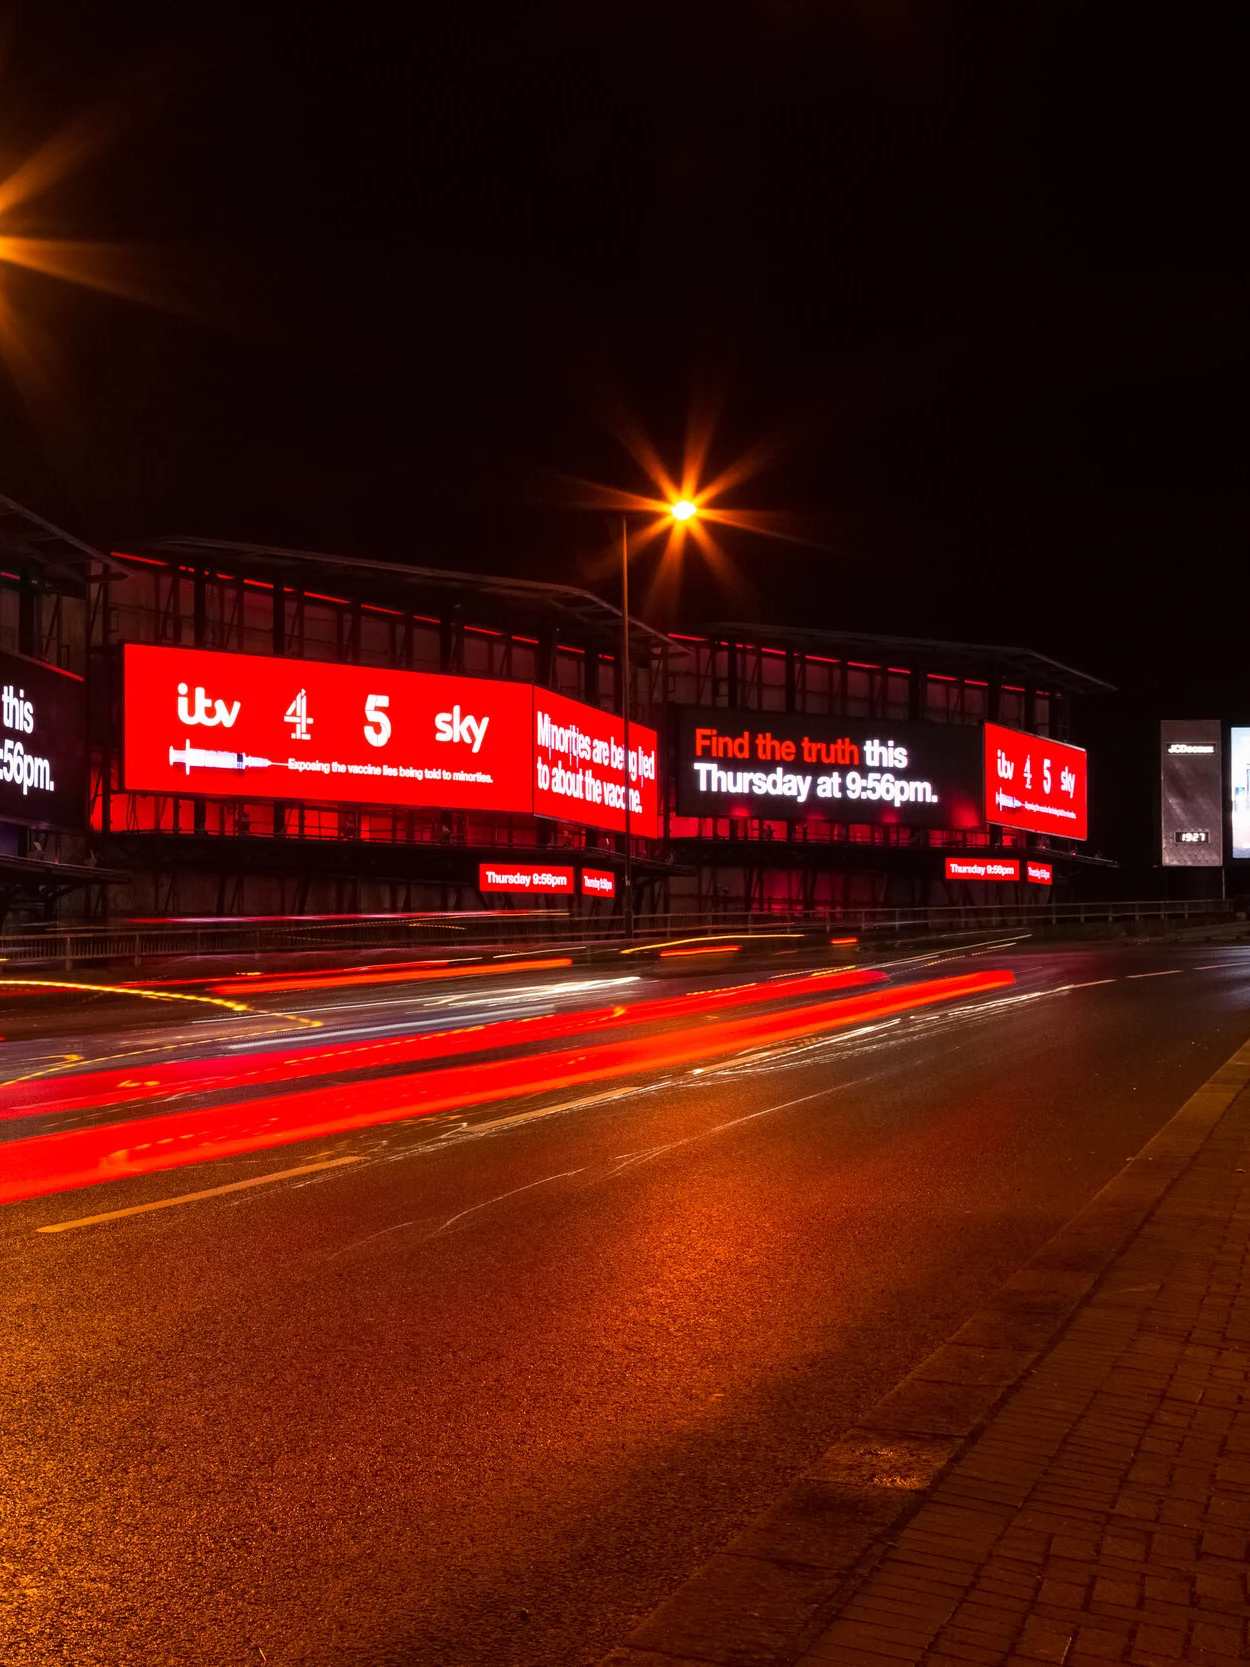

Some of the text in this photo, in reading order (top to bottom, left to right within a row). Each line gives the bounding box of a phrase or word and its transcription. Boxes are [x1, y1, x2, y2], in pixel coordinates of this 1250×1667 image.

[2, 686, 33, 733] this
[178, 683, 489, 753] itv 4 5 sky
[538, 711, 591, 762] Minorities
[592, 739, 609, 766] are
[696, 728, 908, 768] Find the truth this
[288, 758, 330, 774] Exposing
[331, 762, 346, 773] the
[348, 764, 382, 775] vaccine
[383, 765, 398, 776] lies
[399, 766, 423, 780] being
[424, 769, 441, 779] told
[442, 770, 452, 780] to
[537, 756, 550, 790] to
[552, 760, 584, 799] about
[584, 770, 602, 803] the
[694, 763, 938, 807] Thursday at 9:56pm.
[1024, 755, 1032, 789] 4
[1043, 759, 1051, 794] 5
[1061, 766, 1075, 798] sky
[486, 872, 531, 887] Thursday
[533, 873, 567, 887] 9:56pm
